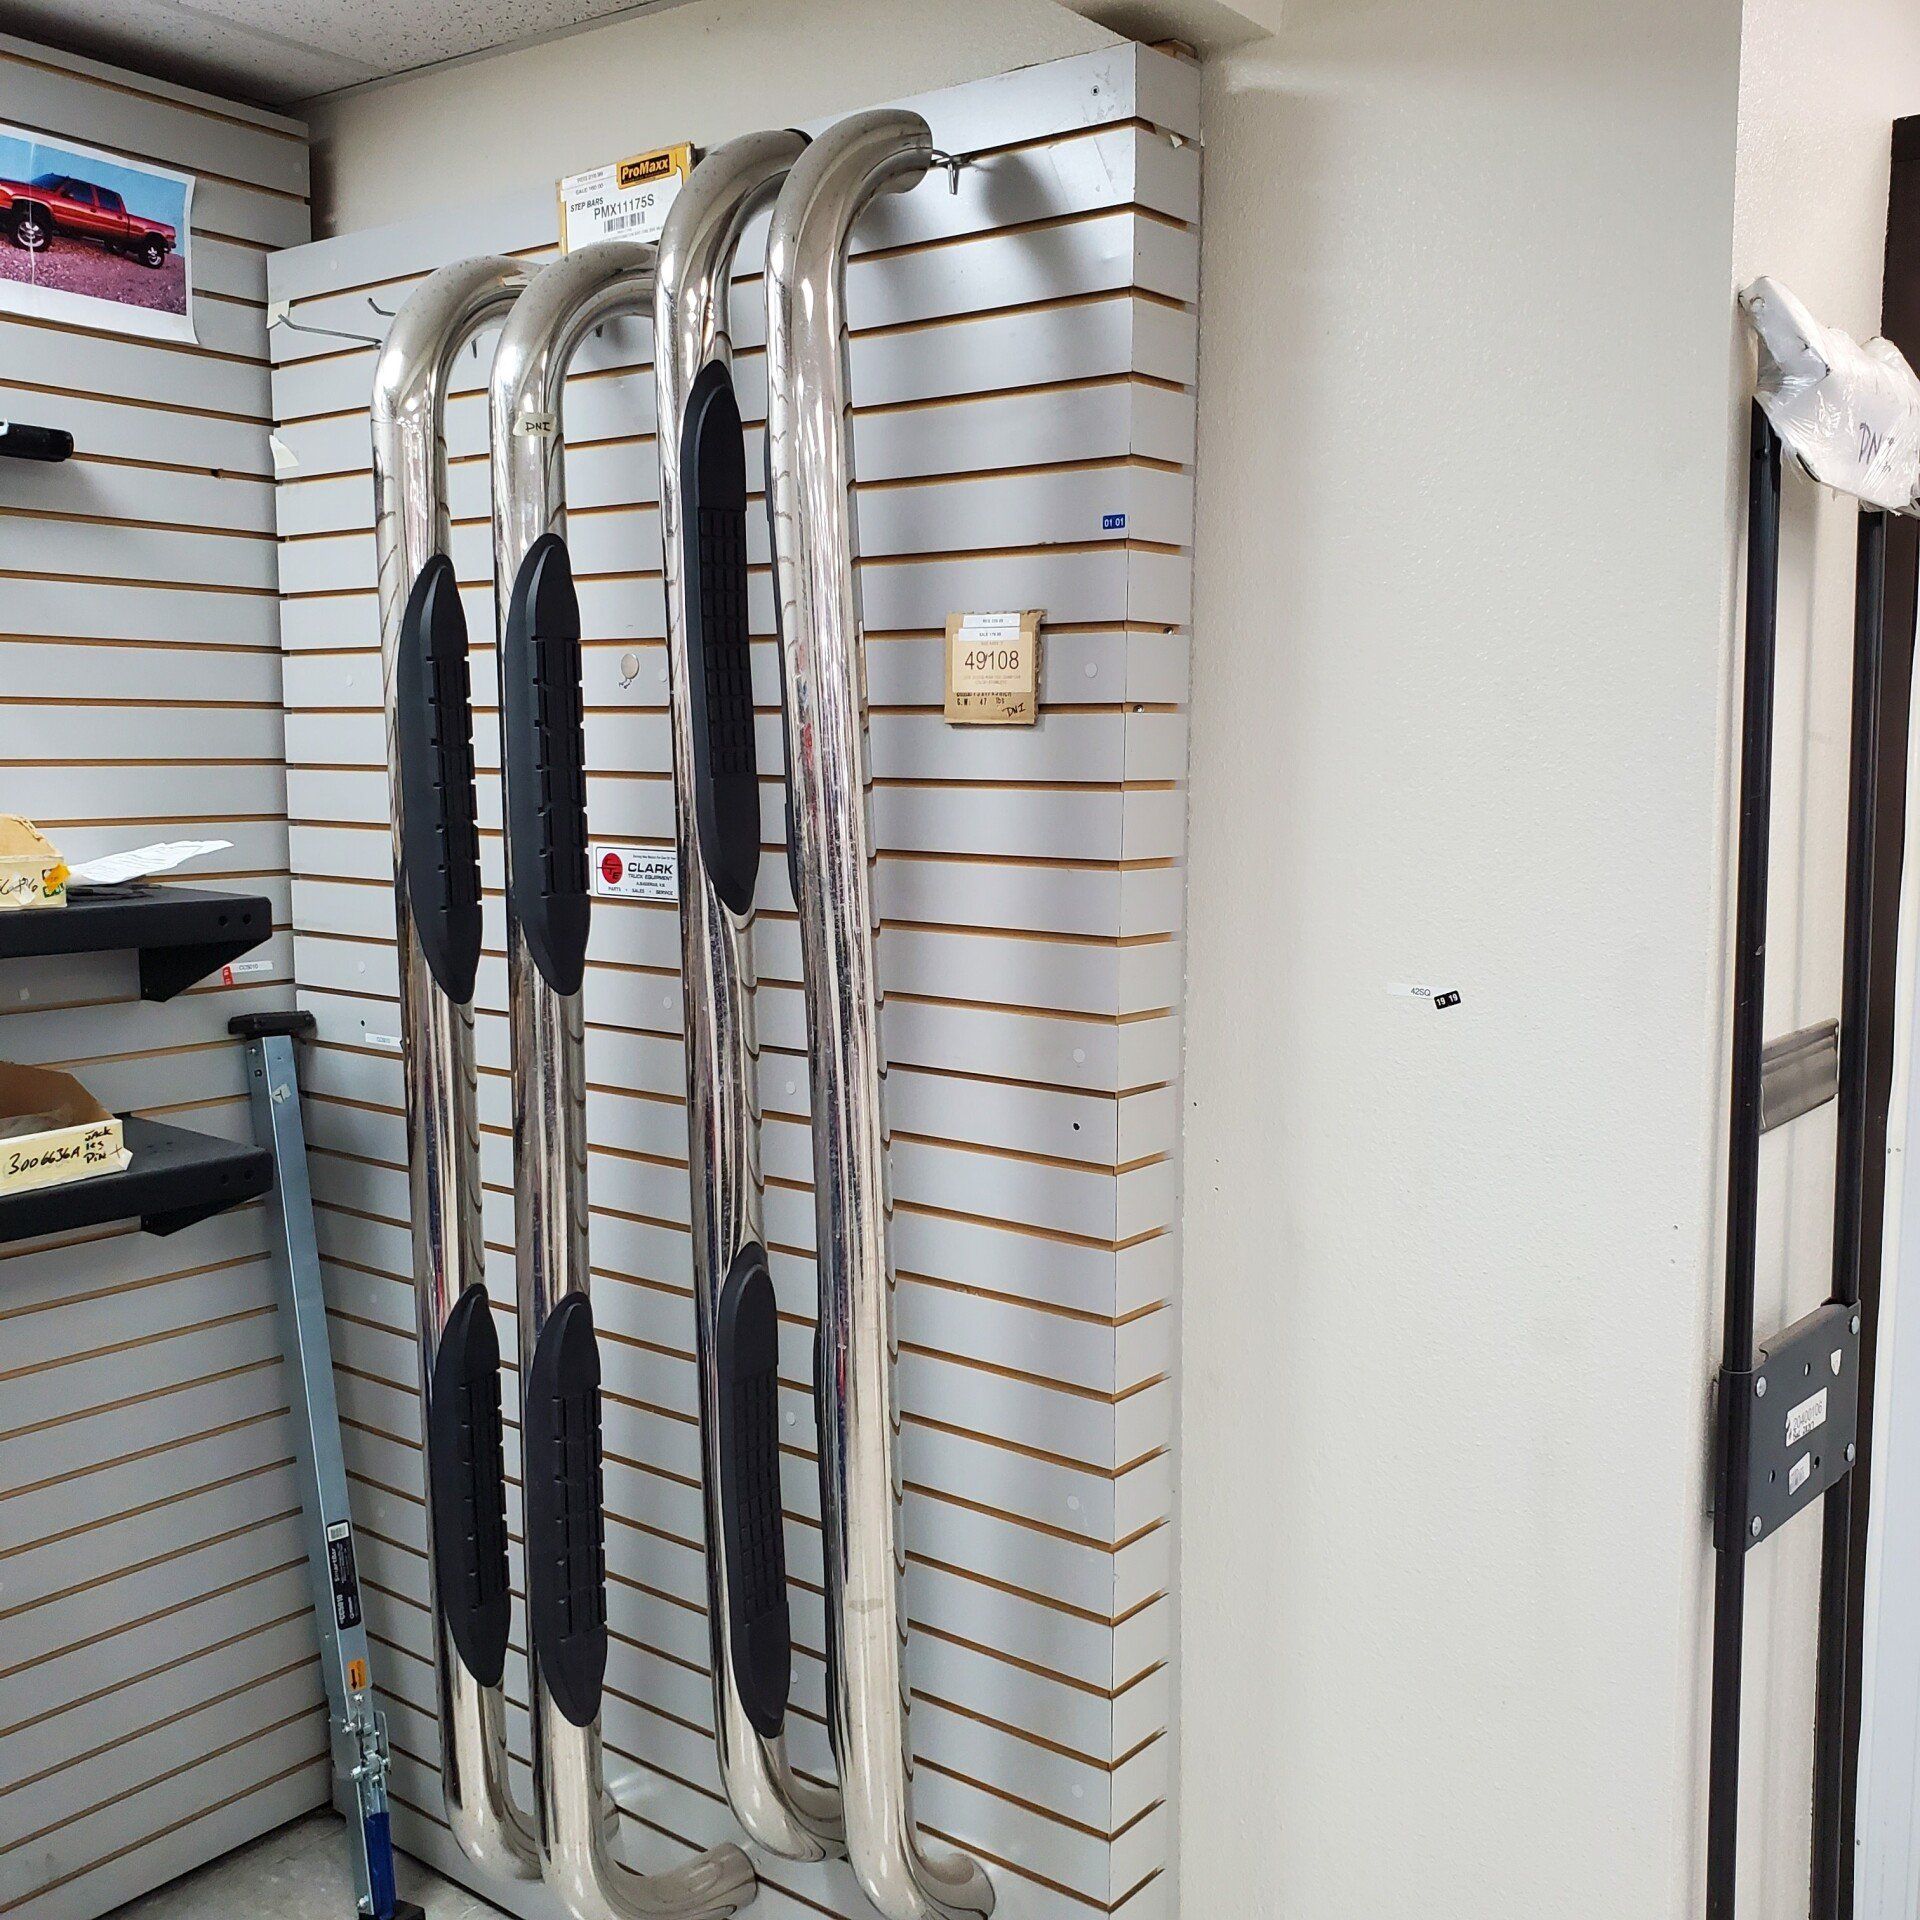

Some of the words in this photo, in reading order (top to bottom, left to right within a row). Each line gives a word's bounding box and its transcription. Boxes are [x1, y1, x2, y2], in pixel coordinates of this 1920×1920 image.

[622, 159, 668, 181] ProMaxx
[570, 201, 585, 213] STEP
[586, 196, 604, 209] BARS
[593, 193, 655, 220] PMX11175S
[525, 421, 551, 432] DNI
[1104, 518, 1113, 528] 01
[1115, 517, 1124, 527] 01
[964, 650, 1019, 670] 49108
[1001, 702, 1026, 718] DNI
[628, 862, 674, 875] CLARK
[1411, 987, 1431, 997] 42SQ
[1436, 997, 1446, 1006] 19
[1449, 993, 1459, 1003] 19
[8, 1146, 81, 1175] 3006636A
